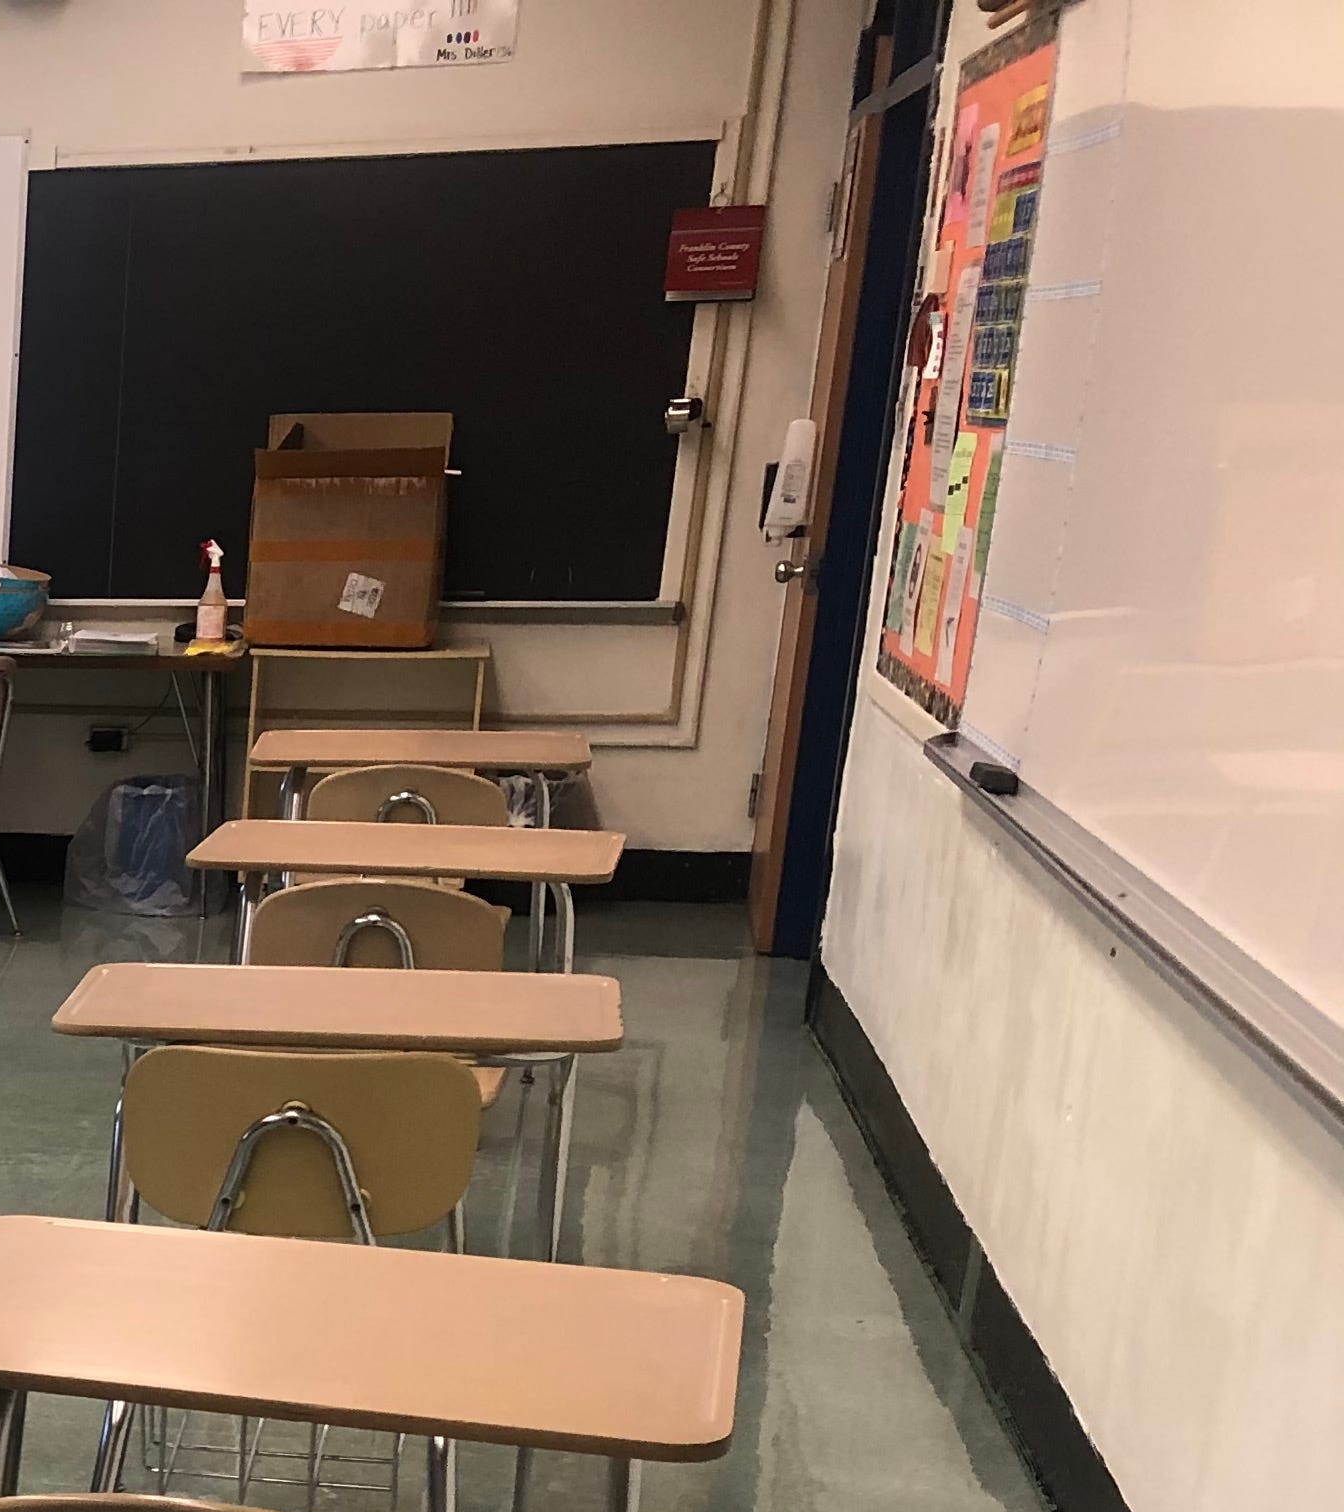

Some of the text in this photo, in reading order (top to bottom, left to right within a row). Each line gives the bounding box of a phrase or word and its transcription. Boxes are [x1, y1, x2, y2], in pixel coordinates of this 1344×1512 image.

[259, 7, 346, 40] EVERY
[360, 9, 437, 45] paper
[436, 48, 457, 61] Mrs
[679, 242, 750, 252] Franklin County
